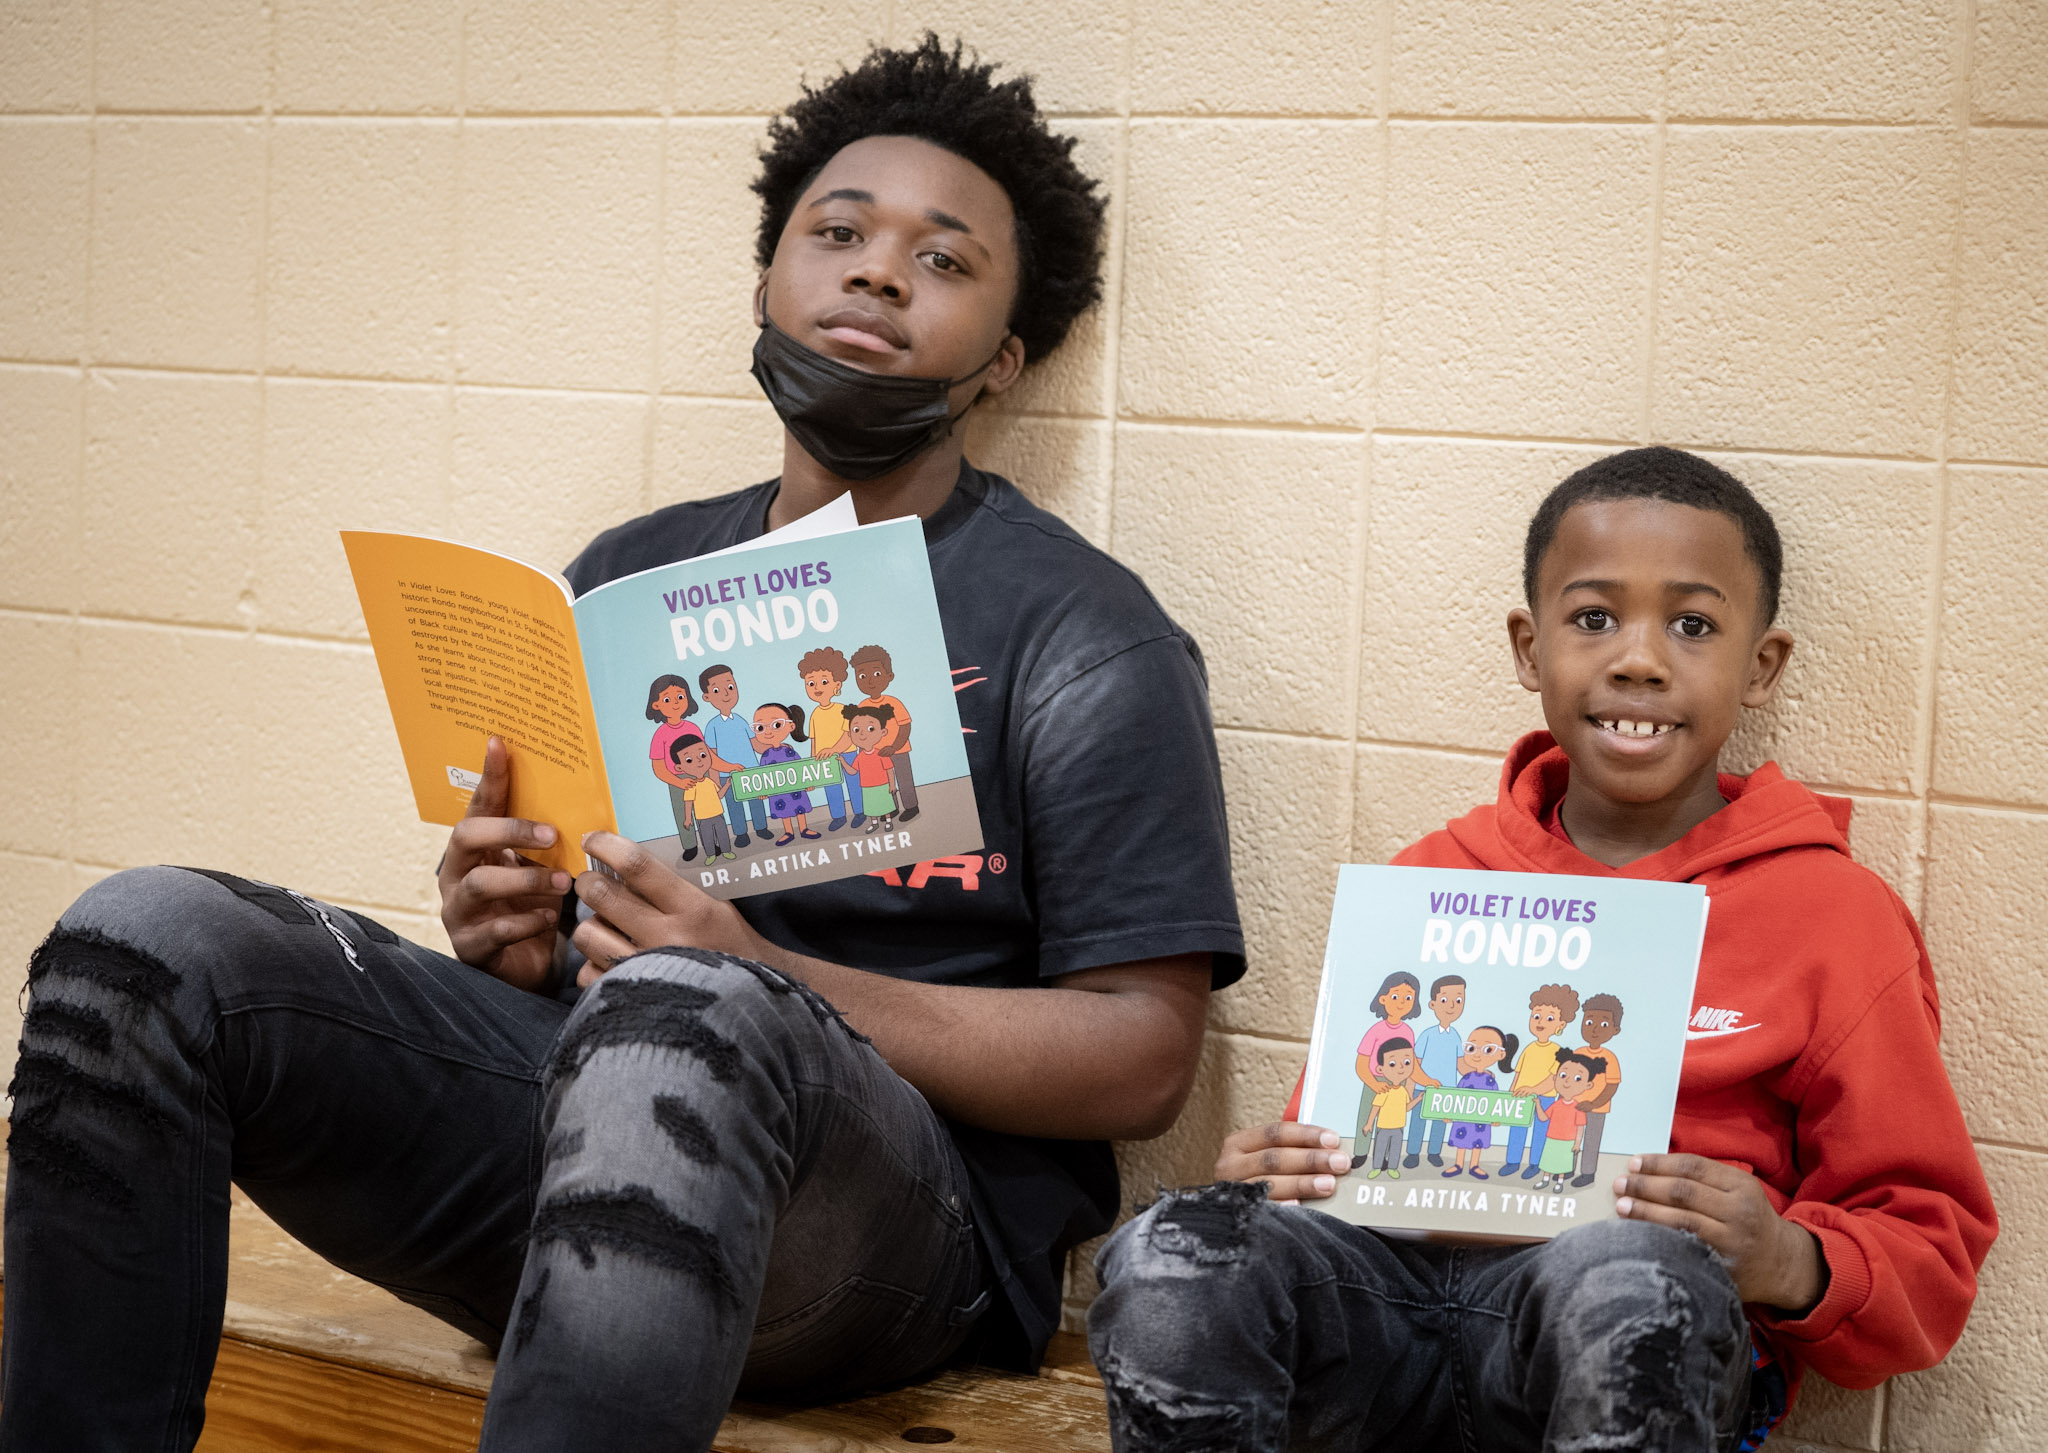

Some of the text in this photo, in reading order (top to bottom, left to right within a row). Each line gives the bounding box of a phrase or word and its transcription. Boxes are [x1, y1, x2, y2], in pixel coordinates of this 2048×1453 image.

[398, 580, 406, 588] In
[410, 581, 432, 592] Violet
[436, 586, 457, 597] Loves
[460, 591, 485, 605] Rondo,
[488, 601, 509, 613] young
[511, 607, 529, 619] Violet
[533, 617, 556, 633] explores
[401, 593, 430, 603] historic
[432, 597, 456, 608] Rondo
[458, 604, 505, 623] neighborhood
[507, 617, 513, 625] in
[514, 620, 523, 630] St.
[662, 561, 832, 614] VIOLET LOVES
[405, 606, 447, 620] uncovering
[449, 612, 458, 621] its
[460, 616, 473, 625] rich
[475, 619, 497, 633] legacy
[499, 628, 506, 636] as
[513, 633, 554, 658] once-thriving
[555, 652, 570, 665] center
[420, 618, 441, 629] Black
[443, 624, 469, 636] culture
[471, 630, 483, 640] and
[486, 635, 514, 651] business
[516, 645, 536, 660] before
[545, 659, 556, 669] was
[557, 665, 573, 681] nearly
[670, 588, 839, 661] RONDO
[411, 630, 448, 642] destroyed
[450, 637, 459, 647] by
[461, 640, 473, 649] the
[475, 644, 515, 663] construction
[518, 659, 525, 667] of
[526, 662, 539, 672] I-94
[548, 672, 558, 682] the
[415, 641, 424, 650] As
[427, 644, 440, 653] she
[443, 647, 465, 658] learns
[467, 653, 487, 665] about
[517, 671, 541, 686] resilient
[543, 682, 556, 692] past
[557, 689, 568, 699] and
[570, 695, 578, 706] the
[417, 655, 580, 718] strong sense of community that endured despite
[421, 667, 441, 676] racial
[481, 680, 501, 692] Violet
[503, 689, 532, 705] connects
[534, 702, 549, 712] with
[551, 710, 583, 733] present-day
[423, 678, 443, 688] local
[445, 683, 493, 702] entrepreneurs
[494, 697, 520, 714] working
[521, 707, 529, 716] to
[531, 712, 556, 728] preserve
[426, 690, 458, 703] Through
[459, 697, 478, 708] these
[518, 718, 529, 728] she
[529, 723, 550, 737] comes
[550, 732, 557, 740] to
[557, 736, 588, 758] understand
[430, 702, 443, 711] the
[446, 706, 485, 722] importance
[498, 721, 527, 740] honoring
[528, 734, 539, 743] her
[541, 740, 567, 756] heritage
[568, 754, 580, 763] and
[580, 760, 590, 770] the
[455, 720, 486, 735] enduring
[514, 741, 549, 761] community
[549, 756, 576, 774] solidarity.
[740, 761, 834, 794] RONDO AVE
[700, 831, 912, 888] DR. ARTIKA TYNER
[1430, 891, 1597, 924] VIOLET LOVES
[1420, 918, 1592, 971] RONDO
[1689, 1005, 1744, 1032] NIKE
[1430, 1093, 1526, 1119] RONDO AVE
[1356, 1184, 1577, 1218] DR. ARTIKA TYNER
